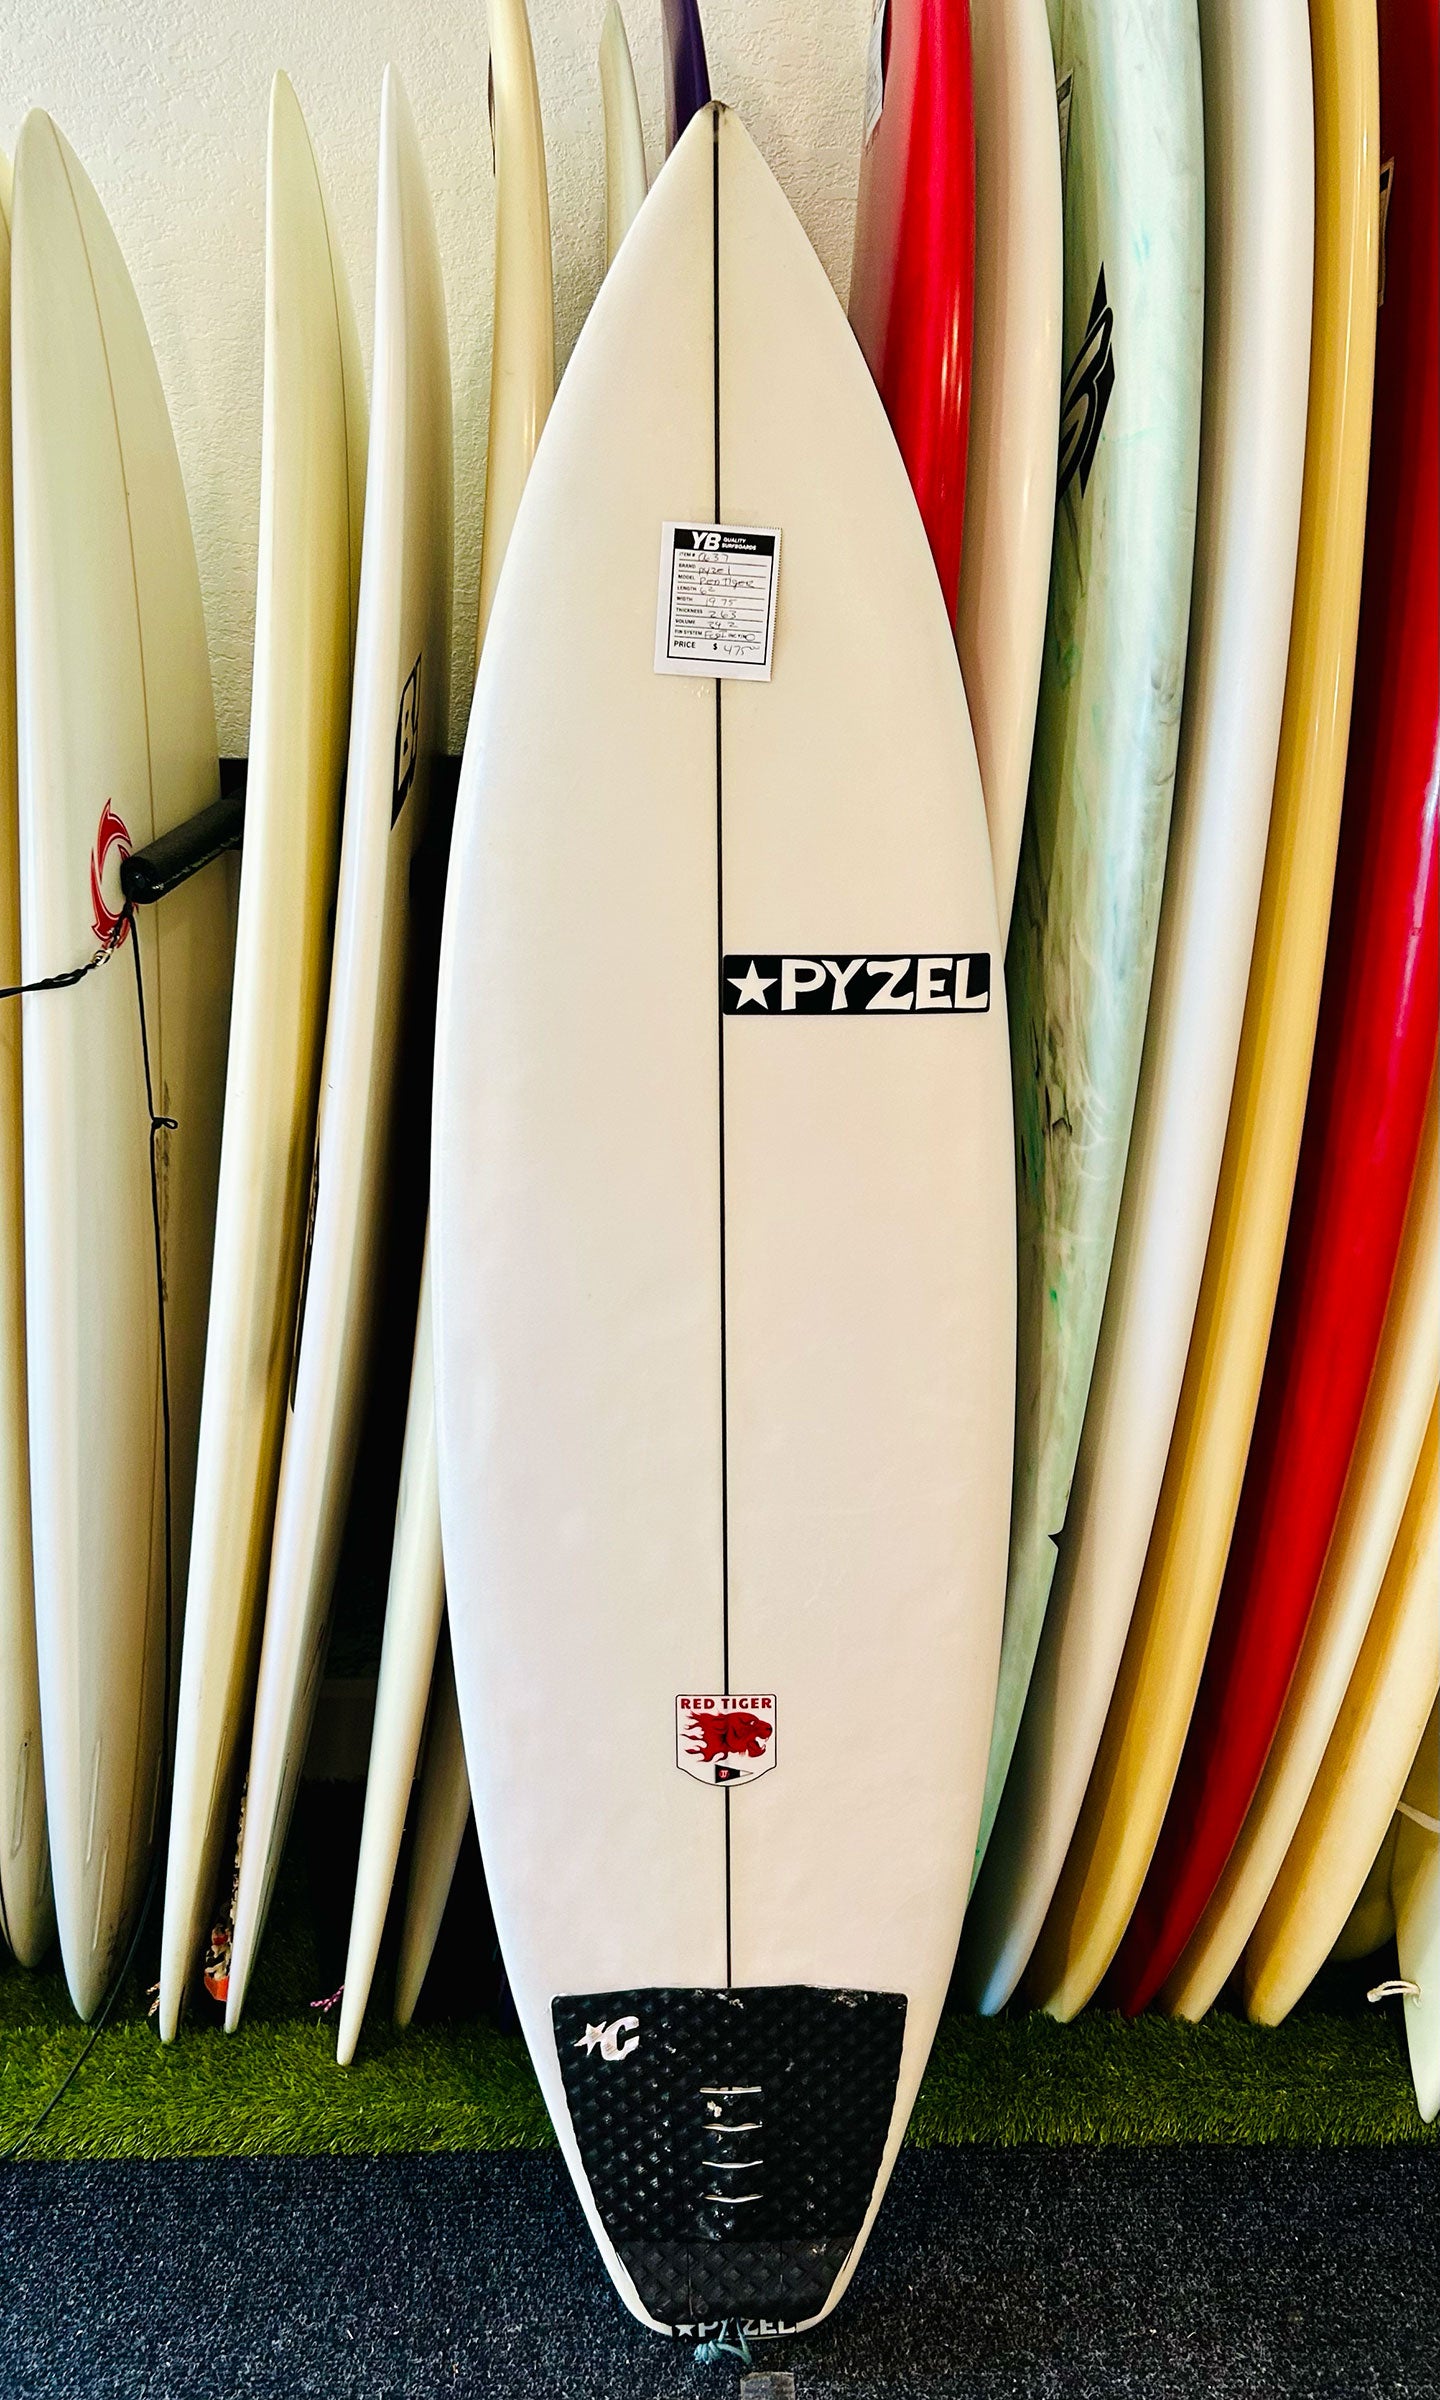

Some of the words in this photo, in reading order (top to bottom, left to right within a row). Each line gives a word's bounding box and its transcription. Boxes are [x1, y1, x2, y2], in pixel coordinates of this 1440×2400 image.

[692, 531, 722, 551] YB
[723, 536, 747, 544] QUALITY
[721, 543, 757, 551] SURFBOARDS
[674, 640, 696, 649] PRICE
[713, 642, 718, 651] $
[781, 957, 988, 1011] PYZEL
[680, 1698, 715, 1710] RED
[721, 1697, 772, 1709] TIGER
